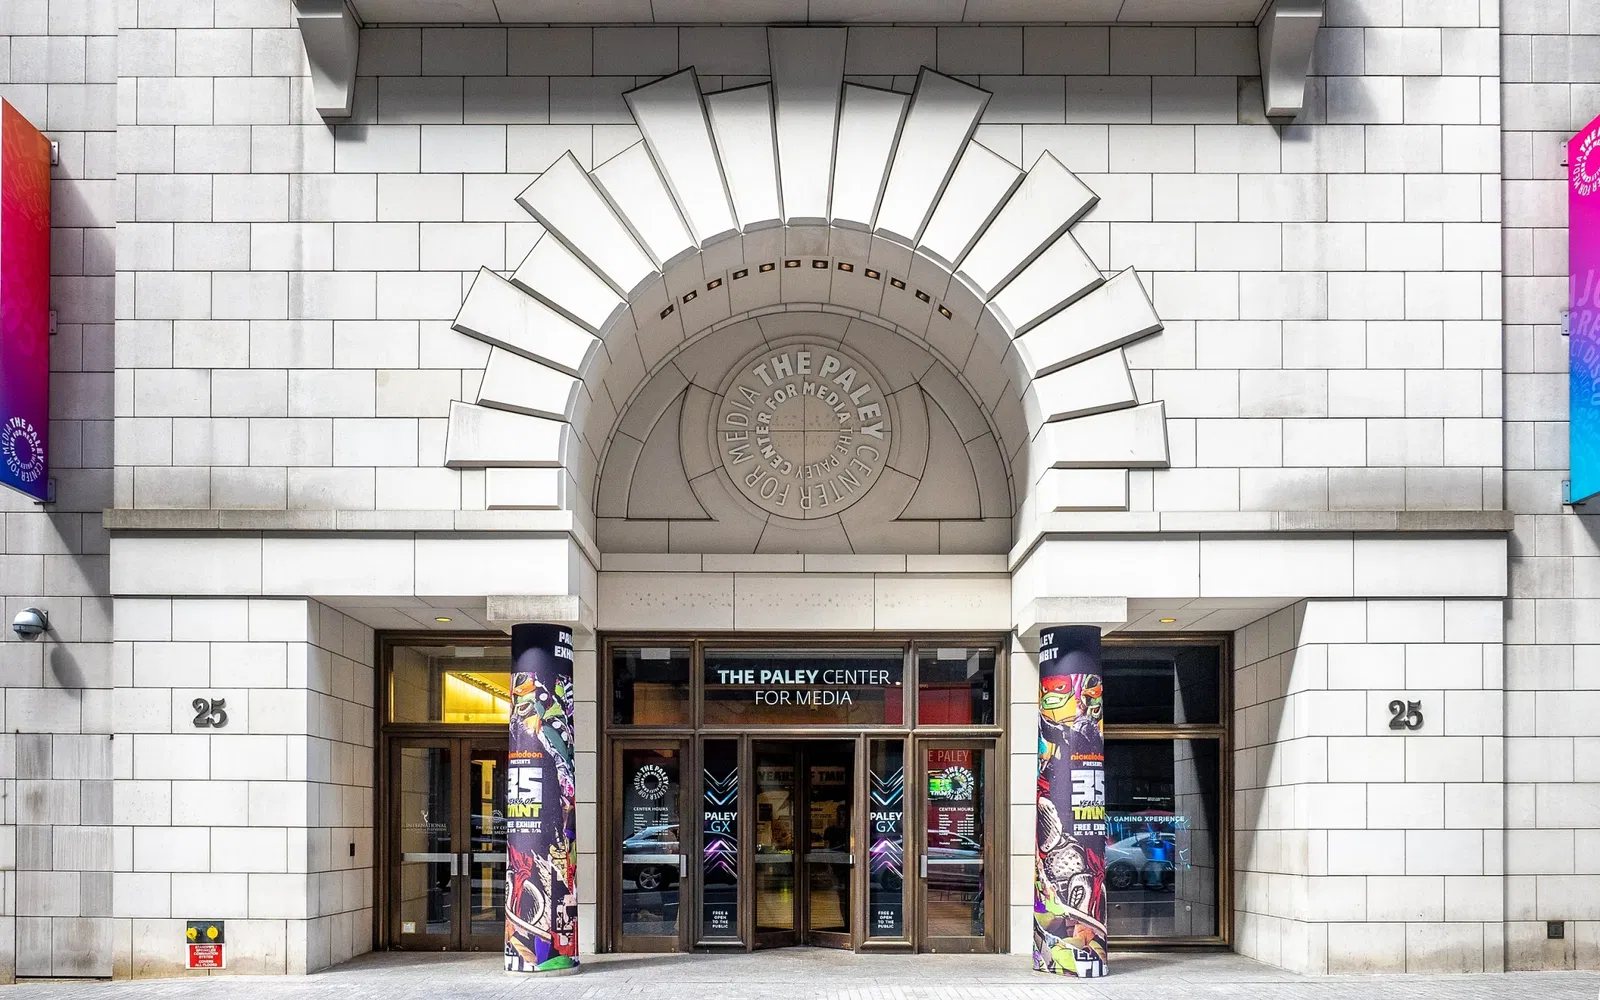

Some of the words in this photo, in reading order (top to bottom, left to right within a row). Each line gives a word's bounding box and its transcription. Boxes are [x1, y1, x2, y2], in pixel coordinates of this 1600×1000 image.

[1580, 129, 1596, 152] THE
[1573, 155, 1583, 189] MEDIA
[752, 352, 812, 386] THE
[766, 384, 798, 410] FOR
[802, 382, 851, 424] MEDIA
[818, 355, 884, 440] PALEY
[10, 417, 26, 428] THE
[726, 385, 761, 465] MEDIA
[2, 424, 12, 455] MEDIA
[27, 424, 44, 462] PALEY
[756, 412, 792, 474] CENTER
[836, 429, 852, 454] THE
[6, 457, 20, 476] FOR
[21, 462, 43, 482] CENTER
[795, 454, 840, 478] PALEY
[745, 465, 790, 506] FOR
[800, 445, 880, 510] CENTER
[1040, 633, 1054, 647] LEY
[718, 670, 755, 684] THE
[760, 670, 819, 684] PALEY
[823, 670, 891, 684] CENTER
[755, 690, 791, 705] FOR
[796, 690, 852, 705] MEDIA
[192, 698, 228, 728] 25
[1389, 700, 1424, 730] 25
[938, 750, 968, 761] PALEY
[640, 765, 653, 773] THE
[654, 766, 669, 784] PALEY
[945, 766, 958, 774] THE
[959, 766, 974, 786] PALEY
[634, 772, 642, 790] MEDIA
[650, 785, 668, 800] CENTER
[705, 812, 737, 820] PALEY
[870, 812, 902, 820] PALEY
[1072, 806, 1104, 819] TMN
[711, 821, 730, 832] GX
[876, 822, 896, 832] GX
